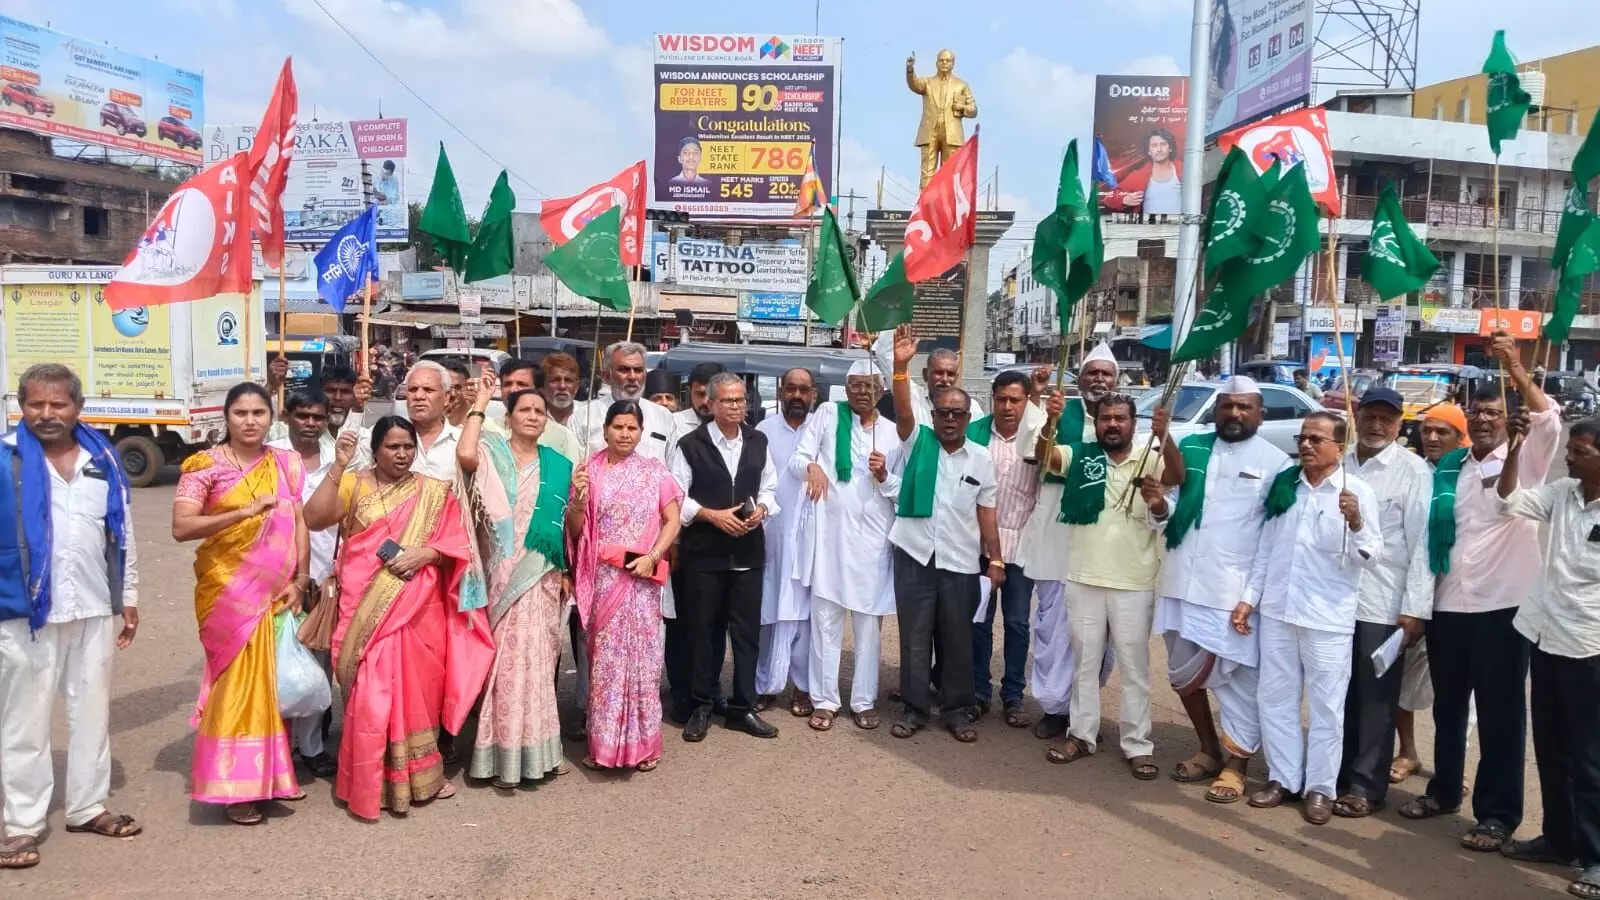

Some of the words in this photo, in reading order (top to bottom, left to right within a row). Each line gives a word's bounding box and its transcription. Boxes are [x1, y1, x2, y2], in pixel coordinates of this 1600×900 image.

[1290, 30, 1302, 46] 04
[658, 35, 754, 53] WISDOM
[1269, 38, 1280, 57] 14
[793, 44, 823, 54] NEET
[1249, 49, 1260, 66] 13
[86, 58, 113, 69] BENEFITS
[660, 71, 699, 80] WISDOM
[701, 72, 759, 81] ANNOUNCES
[761, 72, 825, 81] SCHOLARSHIP
[674, 88, 696, 96] FOR
[698, 88, 722, 97] NEET
[784, 92, 819, 100] SCHOLARSHIP
[1122, 86, 1170, 97] DOLLAR
[670, 97, 727, 106] REPEATERS
[363, 122, 400, 131] COMPLETE
[698, 115, 810, 134] Congratulations
[358, 135, 374, 143] NEW
[375, 134, 395, 142] BORN
[362, 145, 384, 153] CHILD
[385, 144, 404, 152] CARE
[710, 145, 735, 153] NEET
[710, 154, 739, 162] STATE
[751, 147, 804, 170] 786
[683, 186, 711, 194] ISMAIL
[720, 184, 753, 198] 545
[678, 242, 755, 260] GEHNA
[681, 259, 756, 275] TATTOO
[49, 271, 73, 280] GURU
[76, 271, 87, 280] KA
[90, 271, 117, 280] LANG
[28, 289, 51, 297] What
[30, 299, 62, 307] Langar
[1343, 320, 1359, 328] ATM
